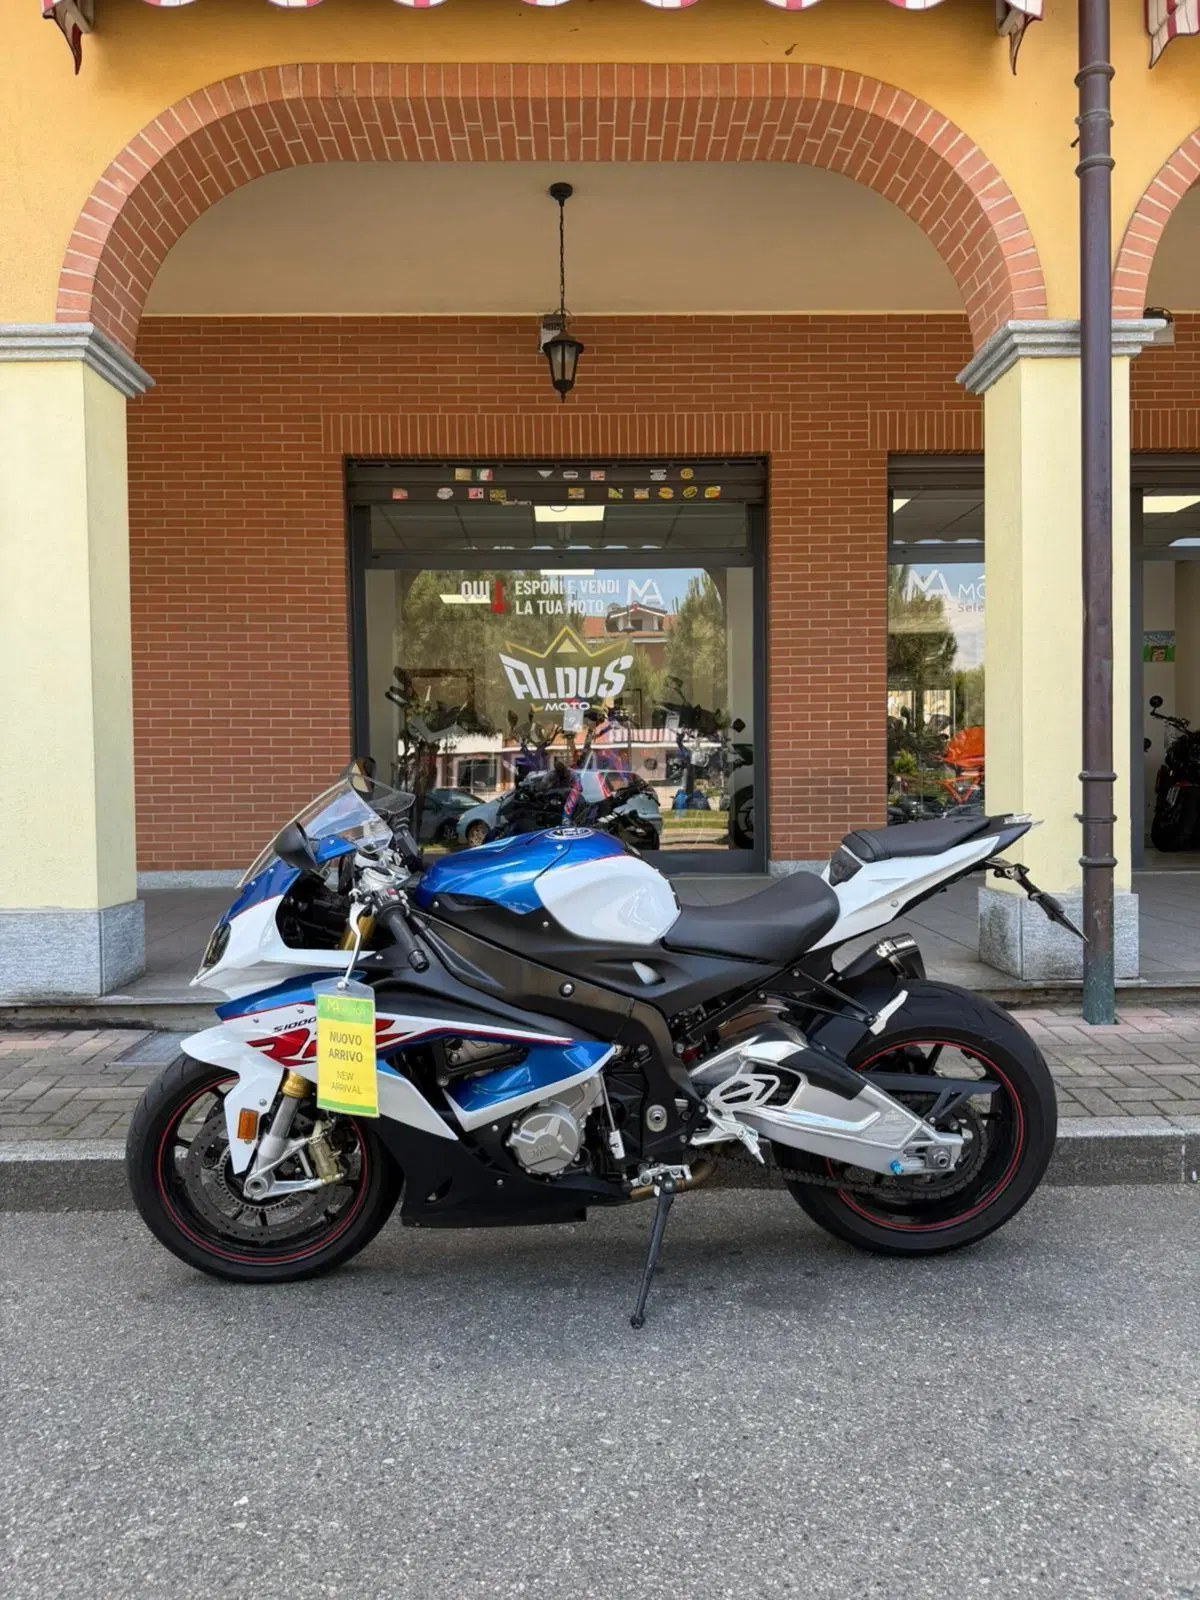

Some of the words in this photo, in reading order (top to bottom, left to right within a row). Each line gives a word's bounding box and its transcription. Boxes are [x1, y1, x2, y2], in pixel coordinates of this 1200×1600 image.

[461, 580, 490, 601] QUI
[515, 580, 564, 596] ESPONI
[568, 581, 576, 595] E
[580, 580, 620, 596] VENDI
[515, 600, 533, 615] LA
[537, 600, 563, 615] TUA
[567, 600, 604, 615] MOTO
[499, 653, 634, 700] ALDUS
[544, 701, 591, 712] MOTO
[329, 1031, 362, 1046] NUOVO
[328, 1049, 363, 1063] ARRIVO
[336, 1071, 354, 1081] NEW
[331, 1081, 363, 1095] ARRIVAL
